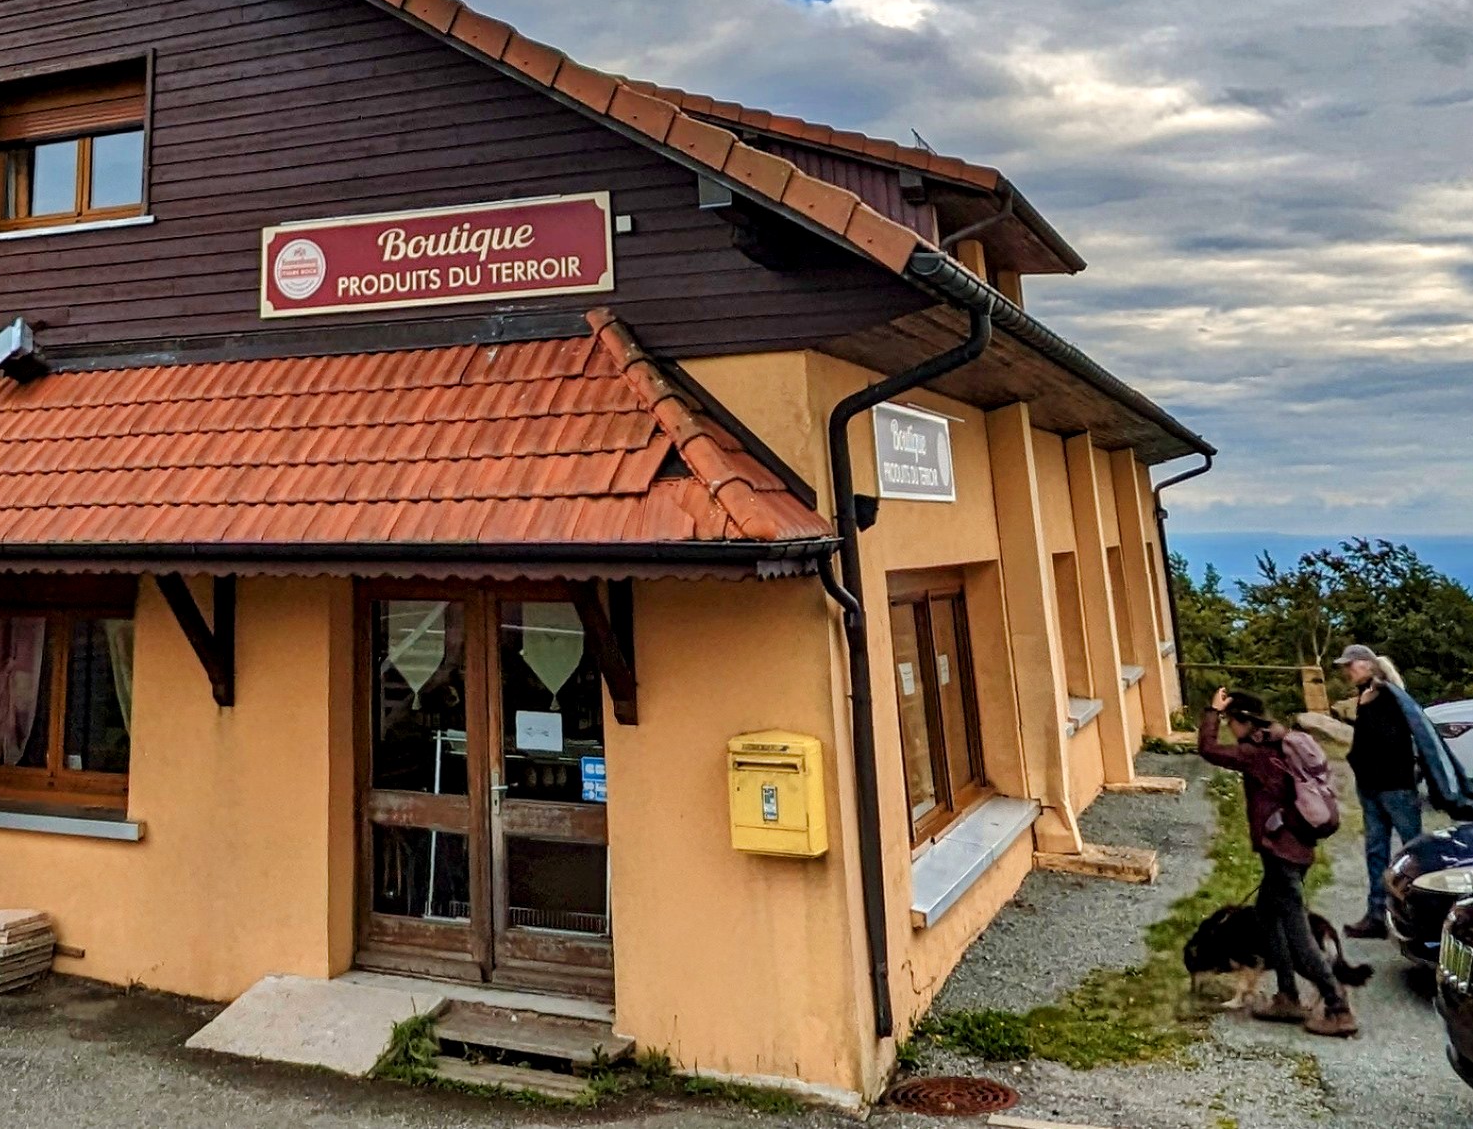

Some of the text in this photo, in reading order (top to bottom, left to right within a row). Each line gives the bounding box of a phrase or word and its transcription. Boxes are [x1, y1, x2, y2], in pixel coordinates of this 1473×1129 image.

[377, 222, 535, 263] Boutique
[337, 268, 441, 298] PRODUITS
[448, 266, 482, 288] DU
[487, 256, 582, 285] TERROIR
